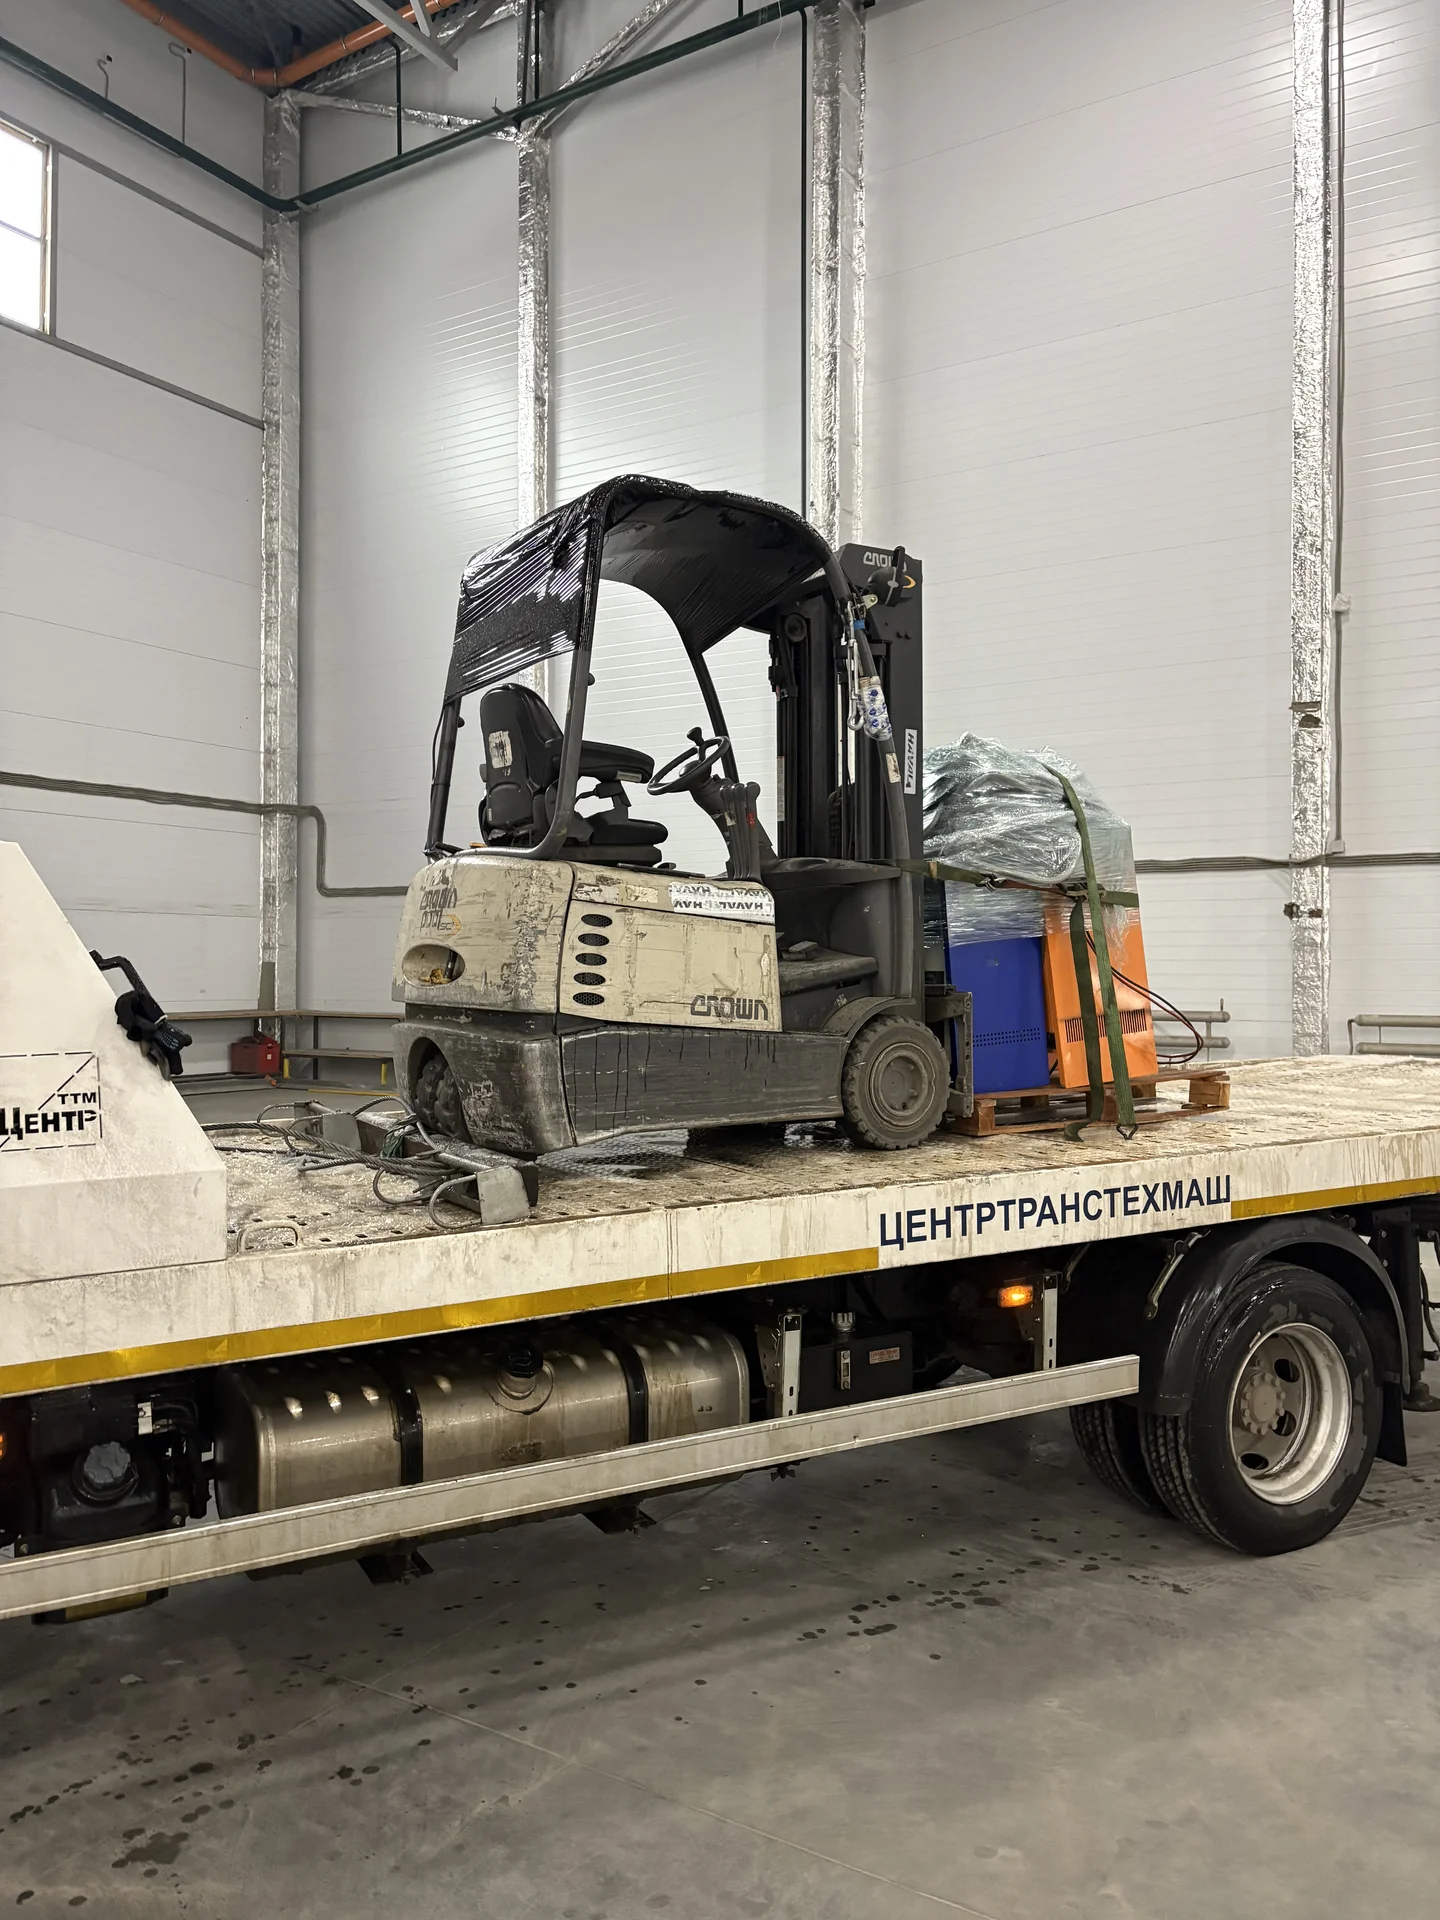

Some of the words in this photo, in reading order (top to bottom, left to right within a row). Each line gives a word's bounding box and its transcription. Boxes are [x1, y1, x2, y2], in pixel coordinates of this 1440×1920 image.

[863, 551, 907, 572] CRO
[907, 732, 915, 785] HAVAL
[719, 901, 763, 910] HAVAL
[691, 994, 768, 1020] CROWN
[57, 1092, 97, 1105] ТТМ
[0, 1107, 97, 1141] ЦЕНТР
[880, 1174, 1231, 1251] ЦЕНТРТРАНСТЕХМАШ
